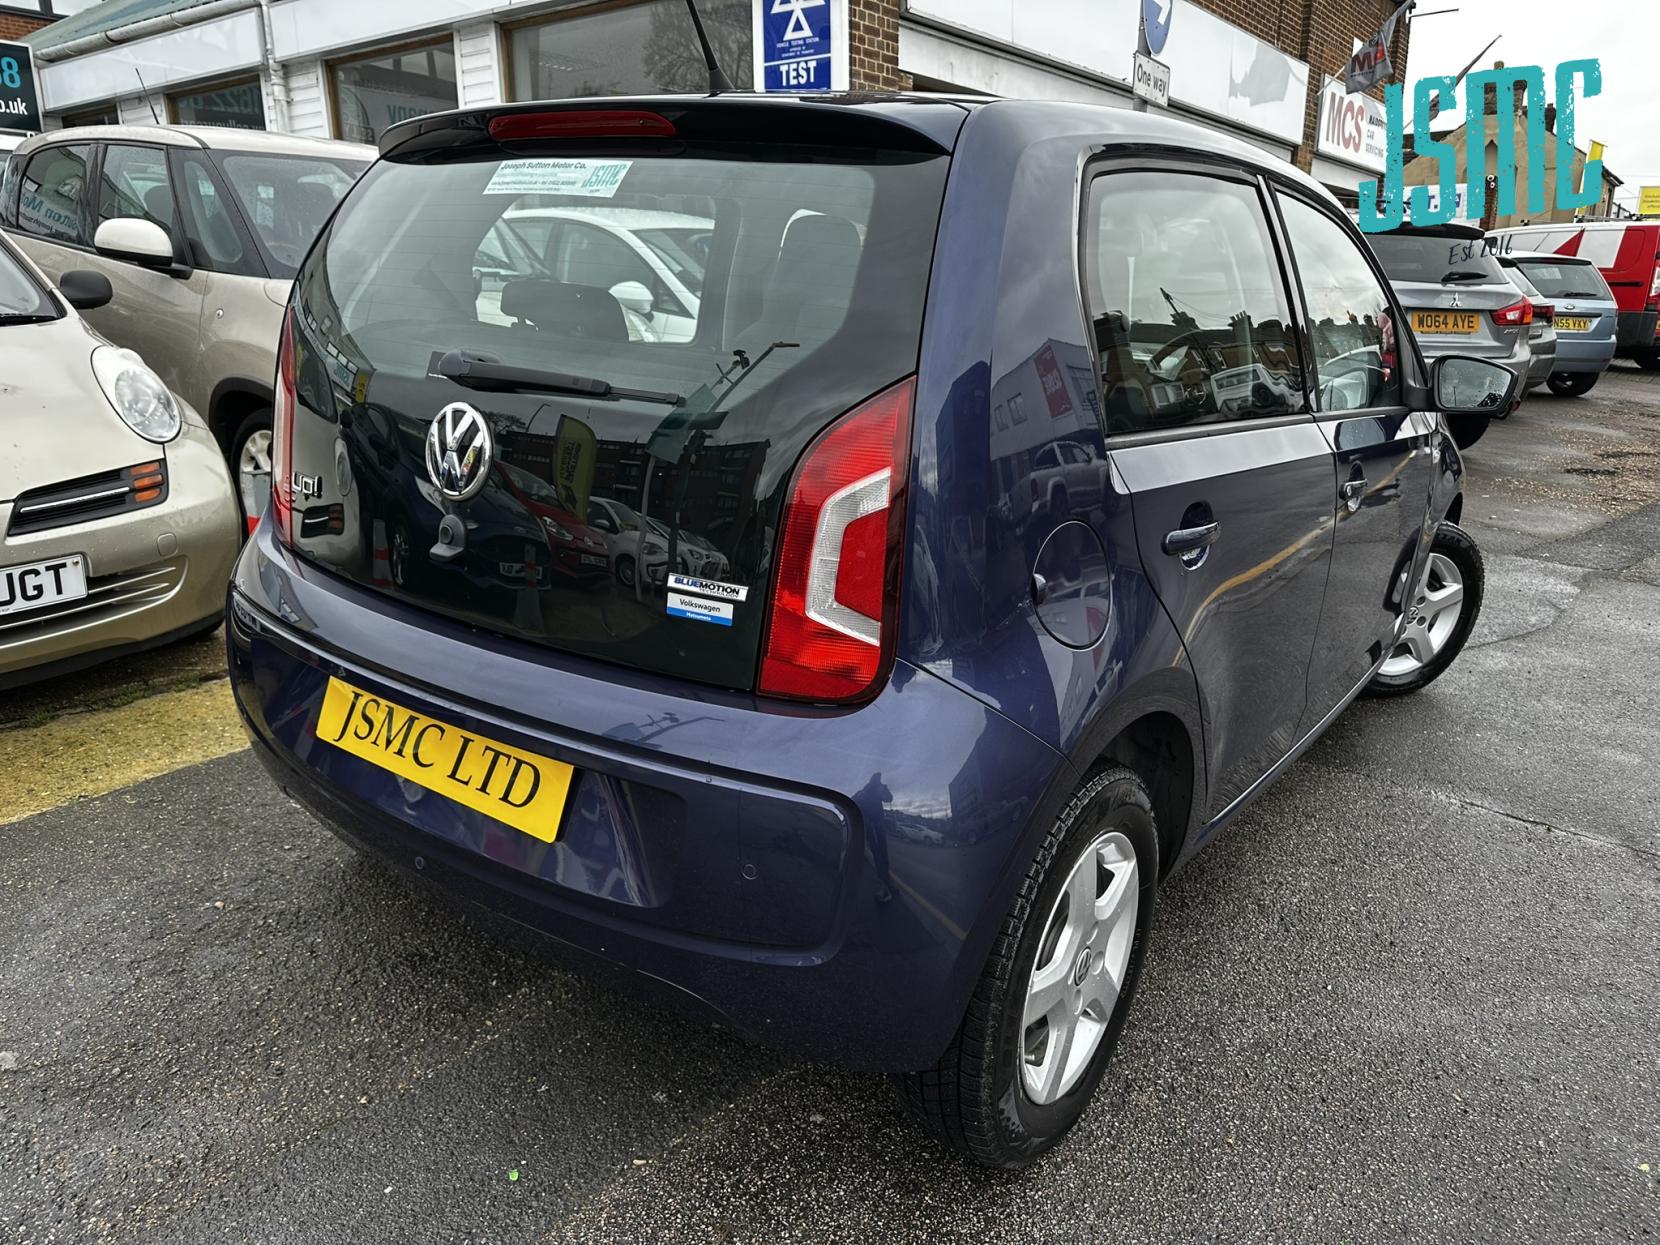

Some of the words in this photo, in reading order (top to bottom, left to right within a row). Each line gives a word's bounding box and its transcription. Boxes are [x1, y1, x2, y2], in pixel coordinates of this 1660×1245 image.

[0, 56, 21, 88] 8
[780, 60, 817, 86] TEST
[1137, 64, 1151, 87] One
[1153, 76, 1167, 97] way
[1326, 91, 1365, 153] MCS
[580, 164, 628, 188] JSMC
[1452, 314, 1475, 329] AYE
[674, 577, 740, 595] BLUEMOTION
[679, 598, 721, 613] Volkswagen
[333, 690, 445, 769] JSMC
[446, 735, 542, 809] LTD
